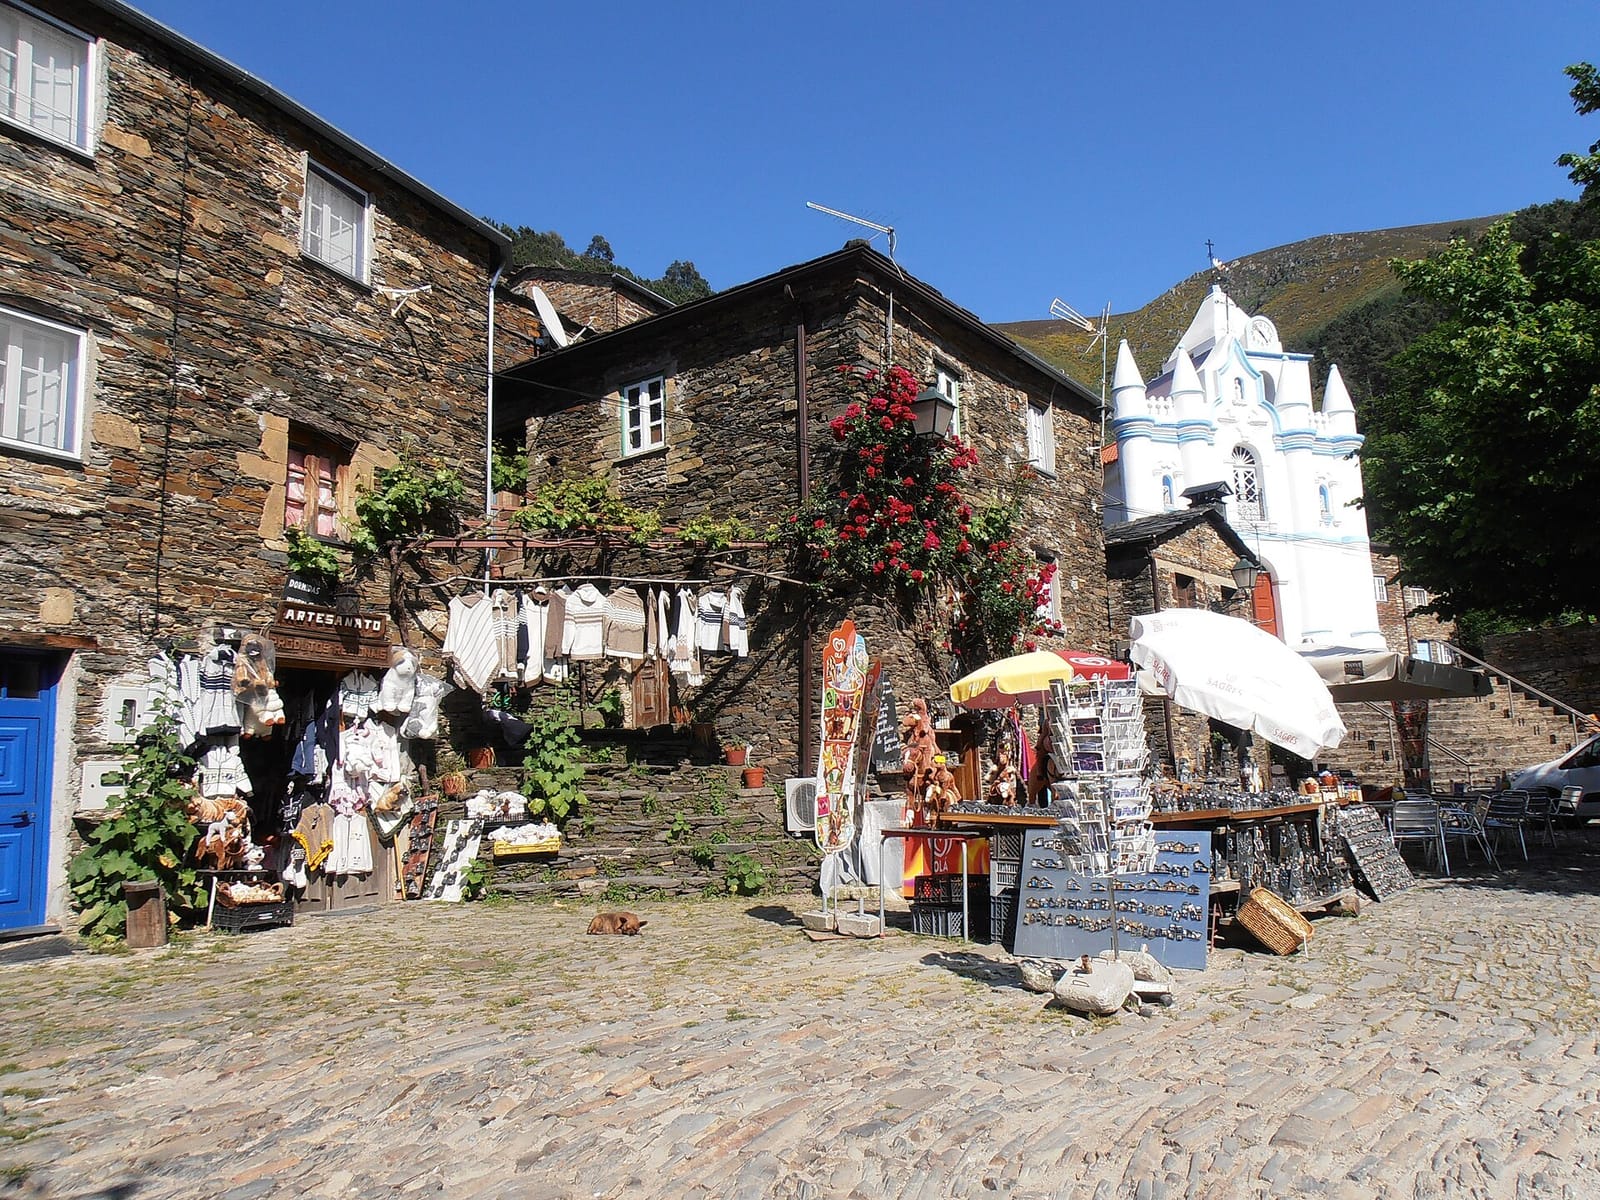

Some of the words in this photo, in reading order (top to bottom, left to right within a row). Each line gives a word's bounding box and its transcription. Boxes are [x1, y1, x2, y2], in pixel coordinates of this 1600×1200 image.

[285, 608, 381, 631] ARTESANATO
[1272, 728, 1298, 745] SAGRES
[933, 856, 949, 873] OLÁ
